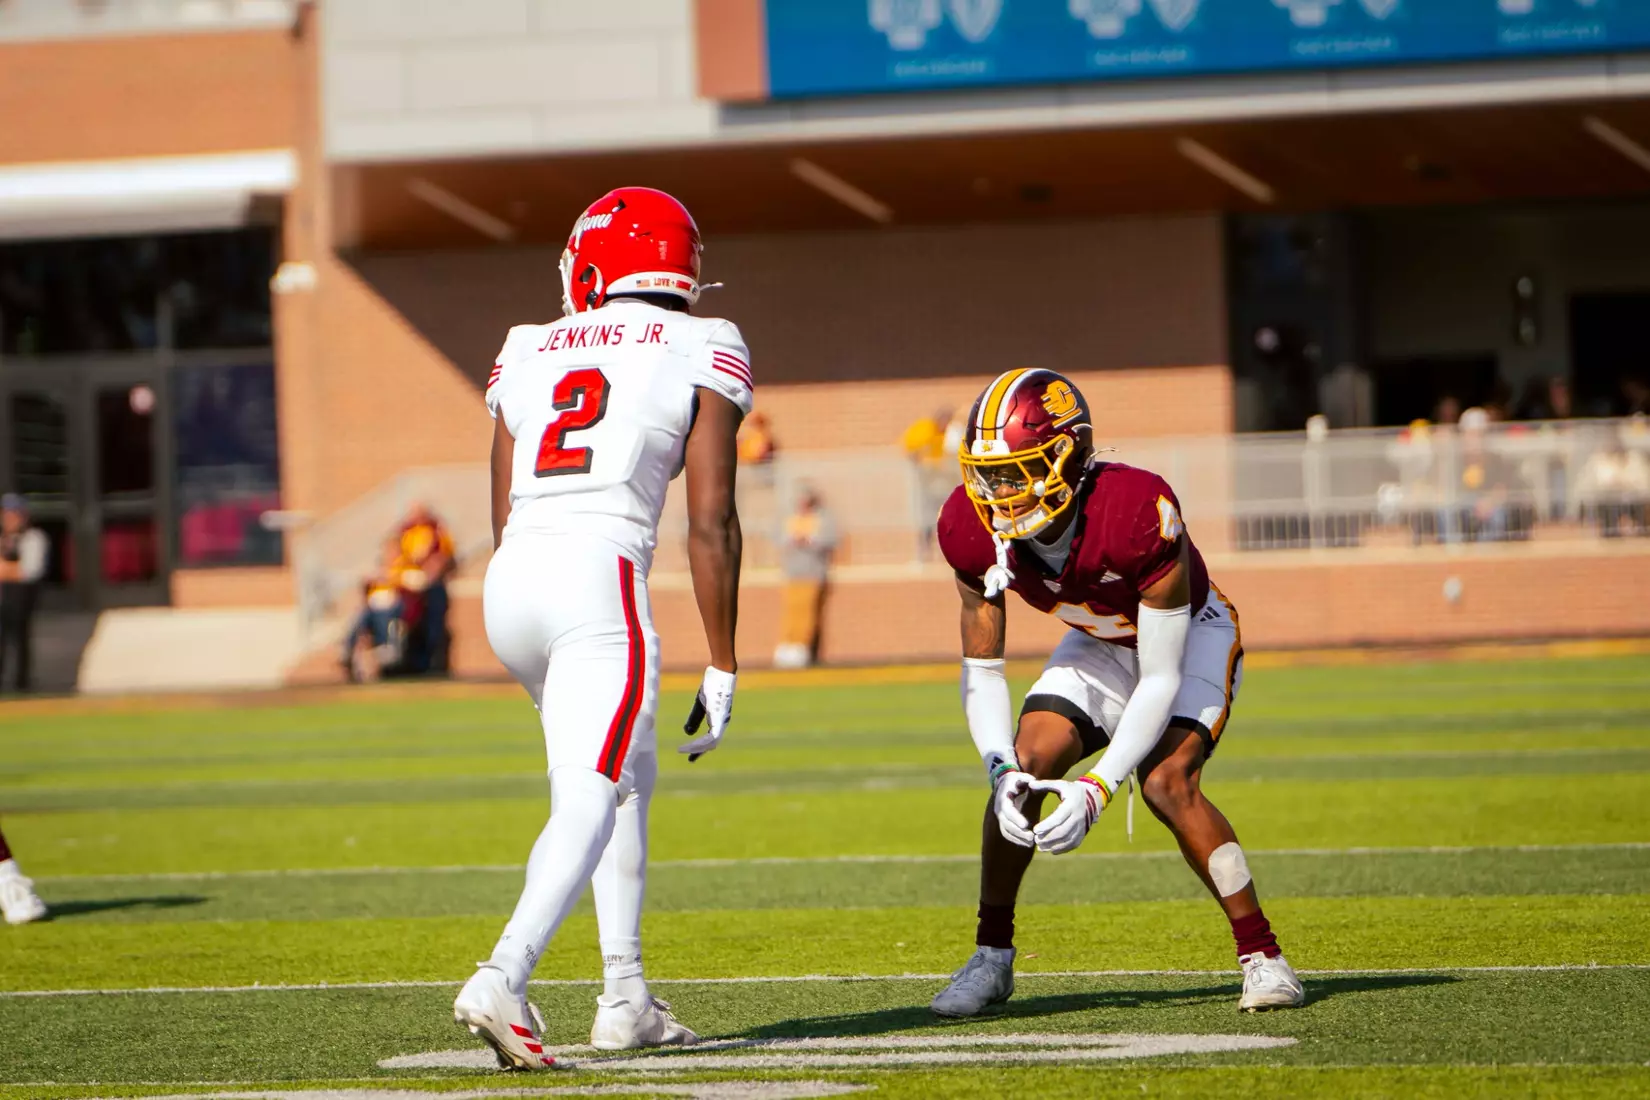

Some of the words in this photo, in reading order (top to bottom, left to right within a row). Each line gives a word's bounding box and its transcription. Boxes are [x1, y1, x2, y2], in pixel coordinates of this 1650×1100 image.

[654, 277, 671, 287] LOVE
[538, 324, 626, 352] JENKINS
[636, 323, 669, 345] JR.
[533, 367, 611, 478] 2
